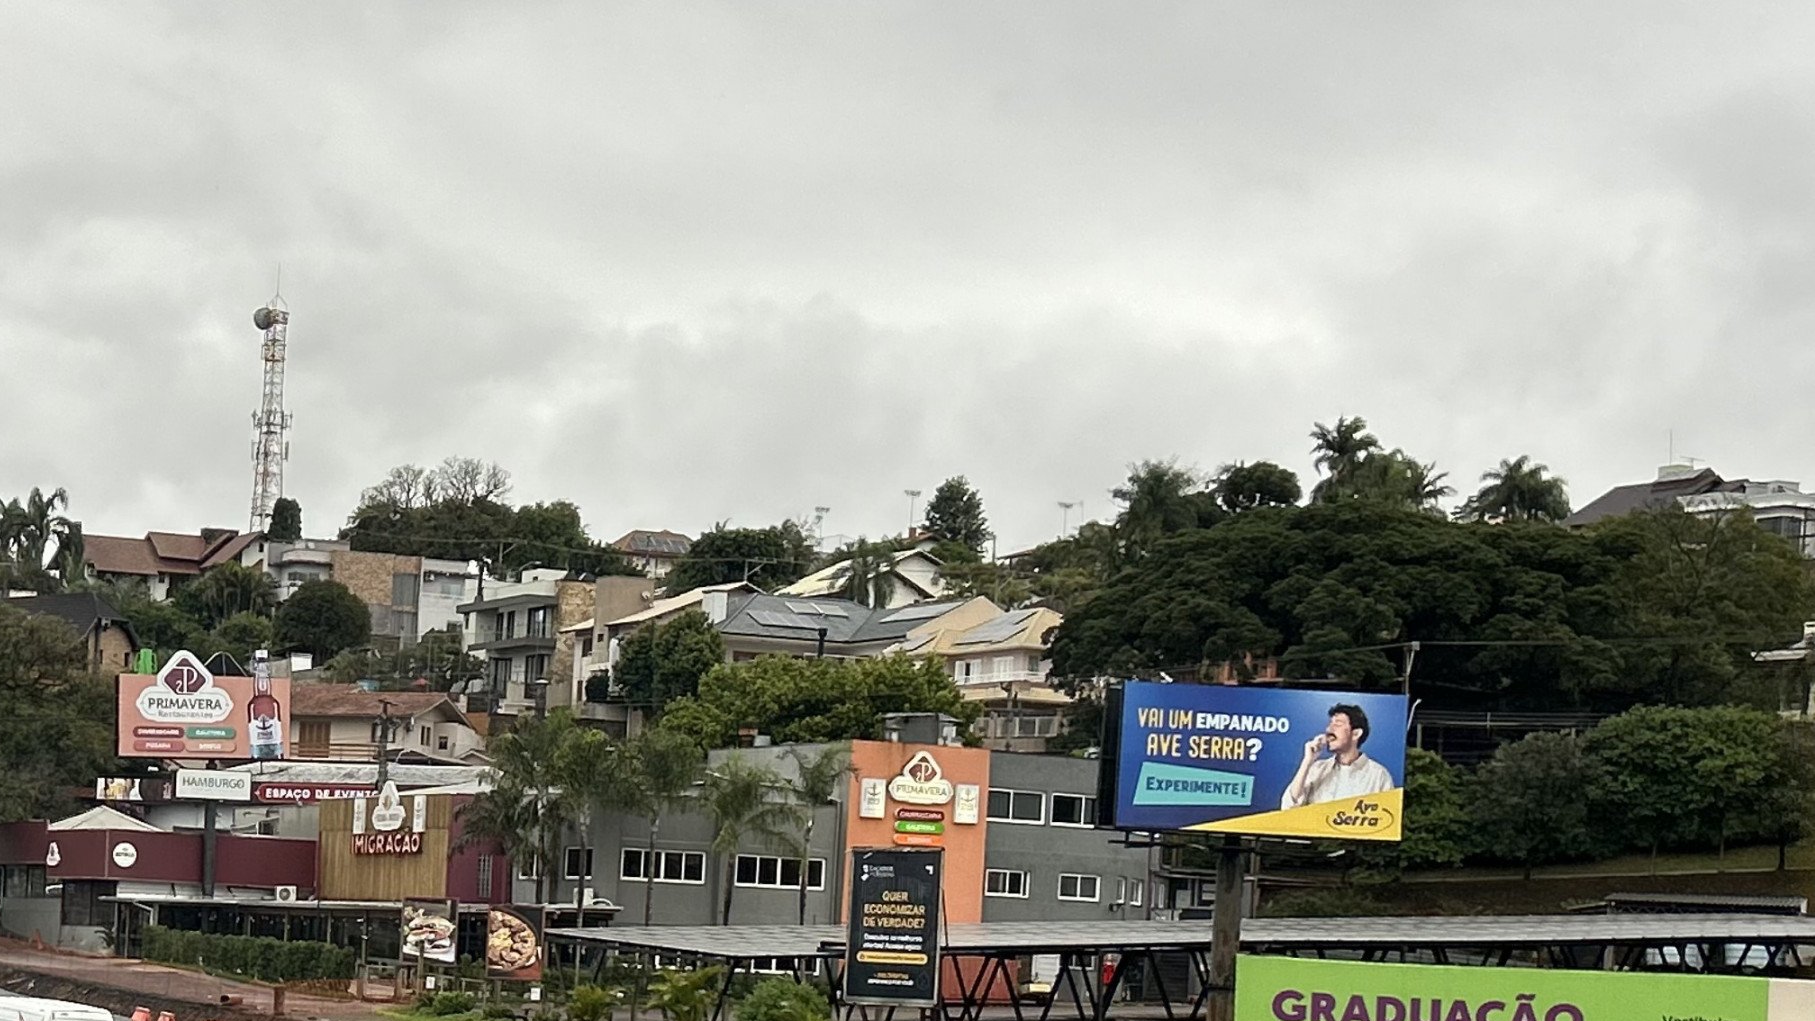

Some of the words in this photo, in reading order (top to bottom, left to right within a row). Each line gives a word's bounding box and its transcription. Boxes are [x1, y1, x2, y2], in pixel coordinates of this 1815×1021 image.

[148, 697, 222, 710] PRIMAVERA
[1138, 707, 1164, 730] VAI
[1168, 709, 1193, 731] UM
[1195, 712, 1290, 733] EMPANADO
[1146, 733, 1182, 757] AVE
[1188, 735, 1263, 762] SERRA?
[182, 776, 246, 789] HAMBURGO
[1145, 776, 1247, 798] EXPERIMENTE!
[896, 783, 947, 797] PRIMAVERA
[1354, 799, 1379, 813] Ave
[1332, 811, 1381, 827] Serra
[882, 890, 909, 902] QUER
[864, 903, 925, 915] ECONOMIZAR
[863, 916, 876, 927] DE
[877, 917, 925, 928] VERDADE?
